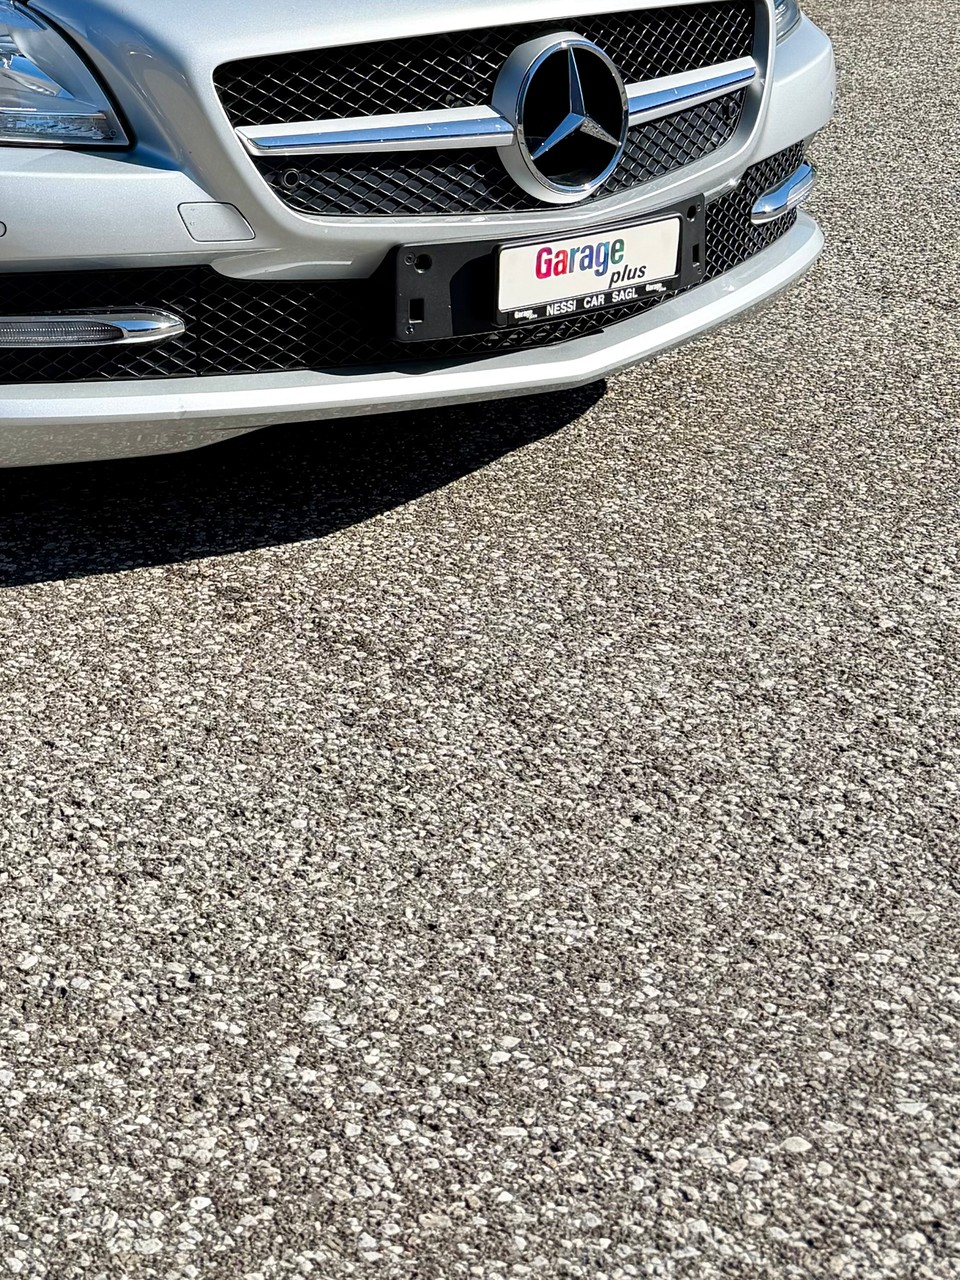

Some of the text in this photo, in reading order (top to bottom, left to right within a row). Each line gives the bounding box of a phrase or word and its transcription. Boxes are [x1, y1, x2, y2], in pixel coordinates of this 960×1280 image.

[536, 239, 624, 279] Garage
[608, 264, 646, 288] plus
[546, 288, 638, 315] NESSI CAR SAGL
